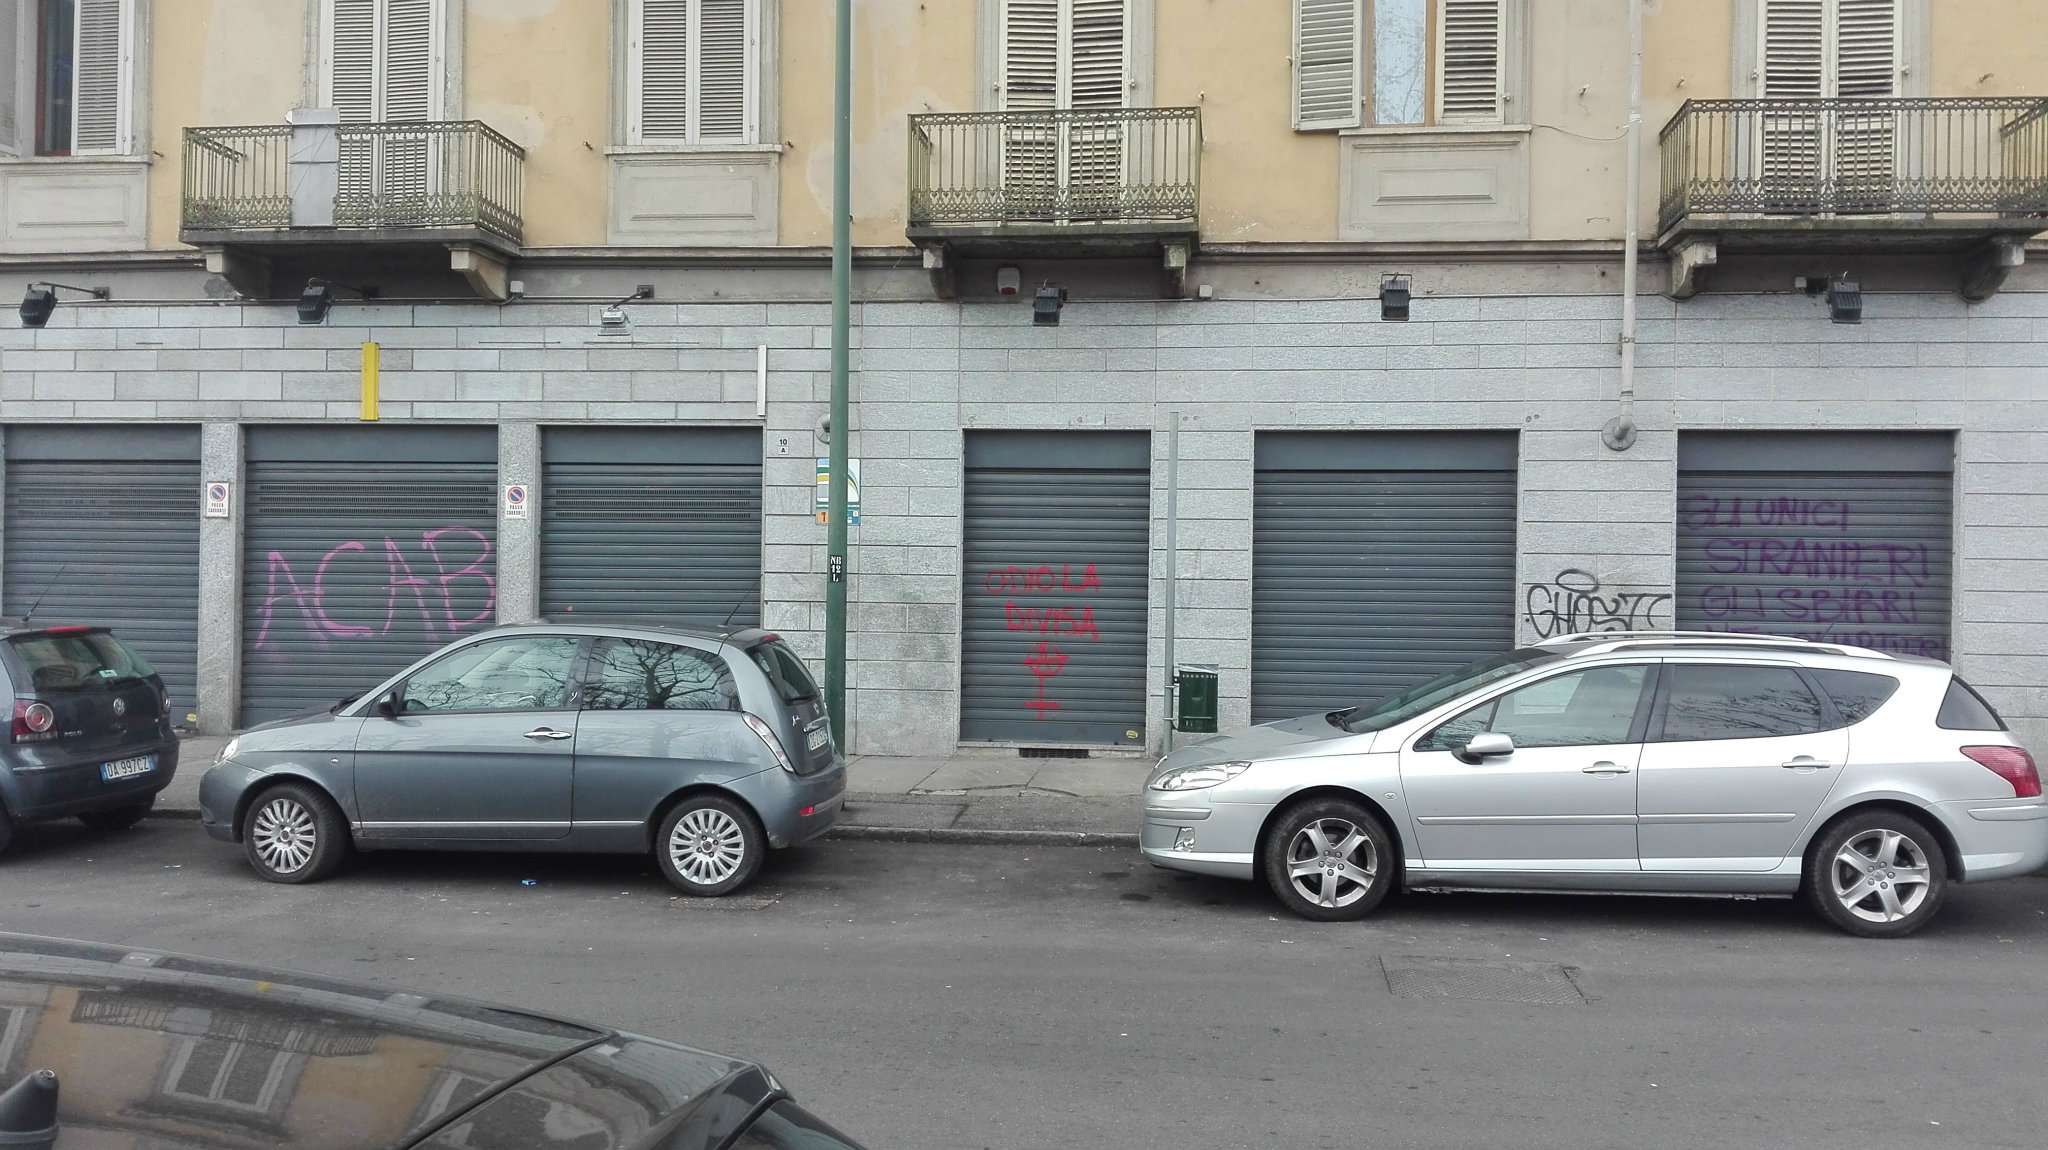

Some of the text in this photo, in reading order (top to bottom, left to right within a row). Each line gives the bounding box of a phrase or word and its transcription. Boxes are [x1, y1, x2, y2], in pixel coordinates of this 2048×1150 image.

[779, 438, 788, 446] 10
[1755, 497, 1849, 531] UNICI
[985, 561, 1103, 596] ODIO LA
[1704, 538, 1930, 588] STRANIERI
[256, 526, 496, 649] ACAB
[1702, 586, 1919, 625] GLI SBIRRI
[1004, 601, 1099, 640] DIVISA
[120, 758, 149, 774] 997CZ
